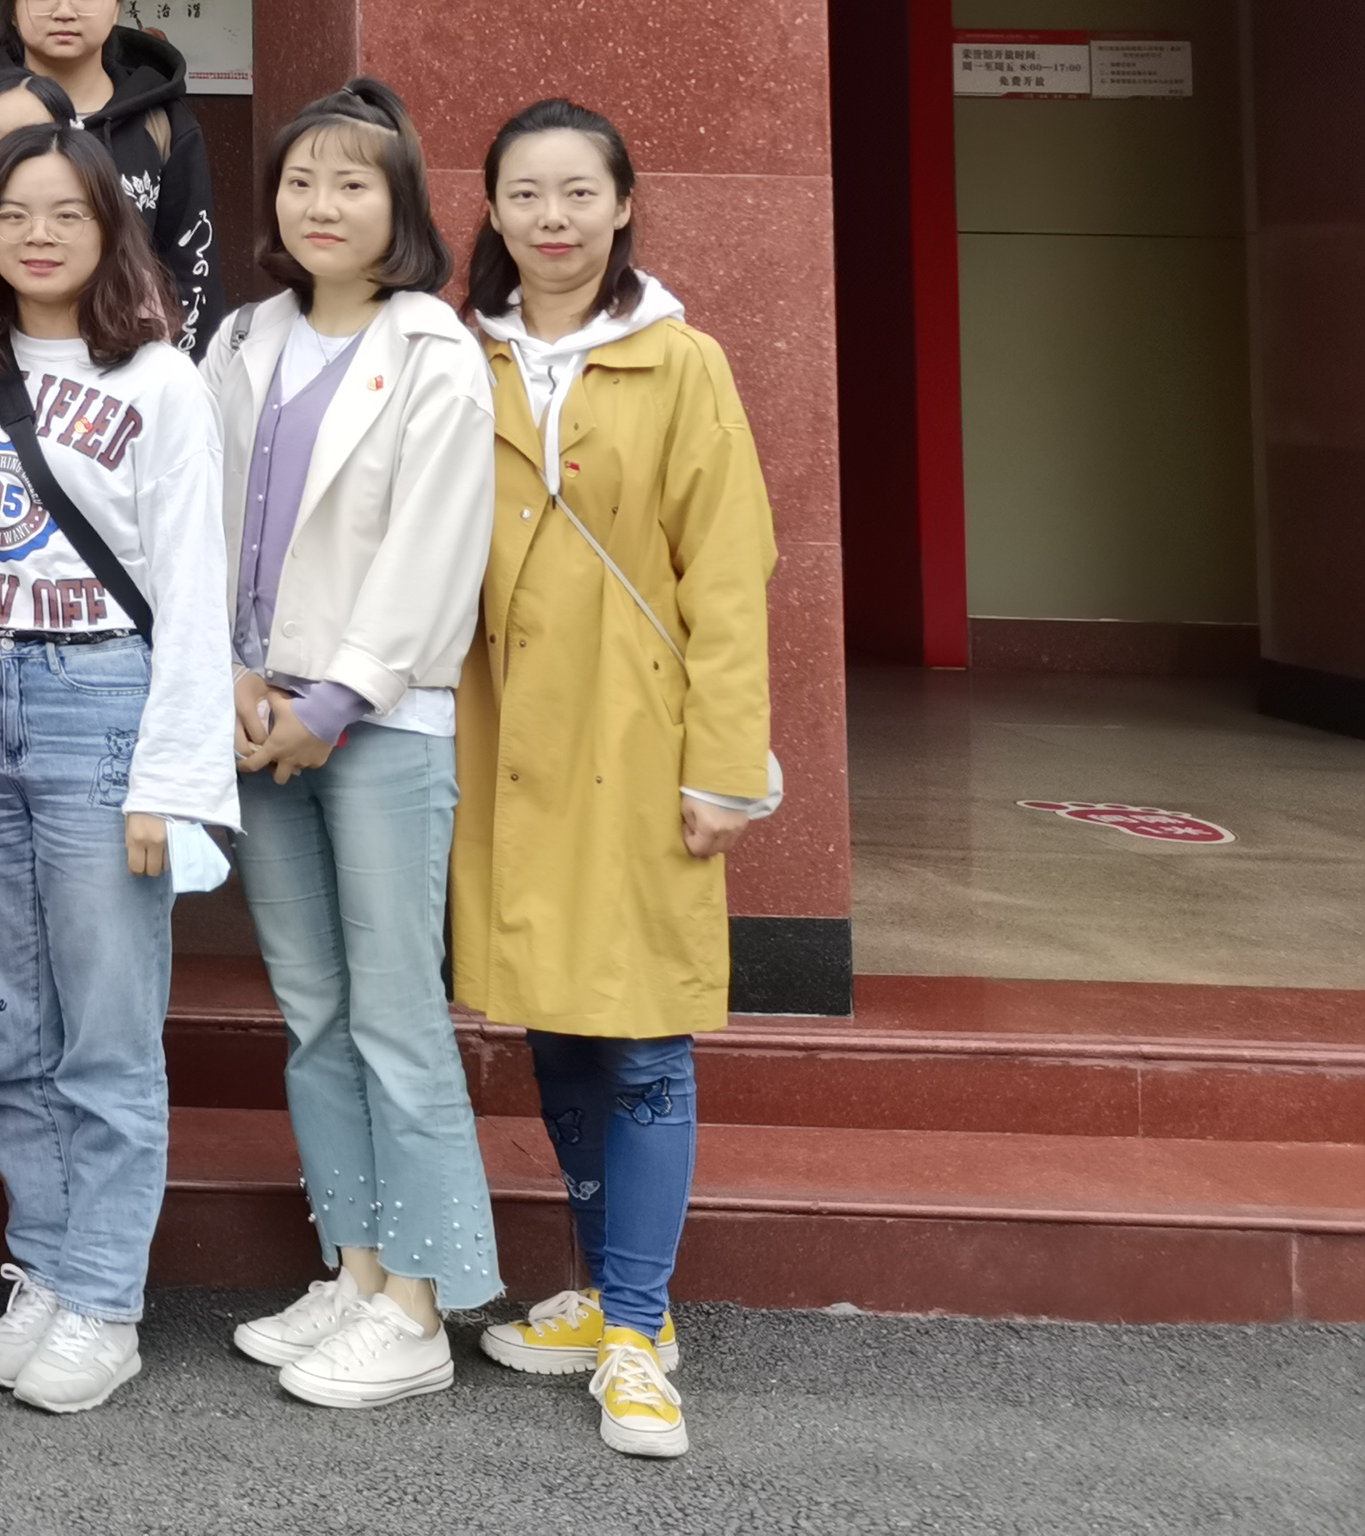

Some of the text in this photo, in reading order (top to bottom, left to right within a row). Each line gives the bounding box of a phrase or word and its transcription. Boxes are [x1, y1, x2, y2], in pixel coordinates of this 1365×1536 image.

[999, 76, 1045, 87] 免费开放
[3, 522, 31, 544] WANT
[32, 577, 108, 629] OFF
